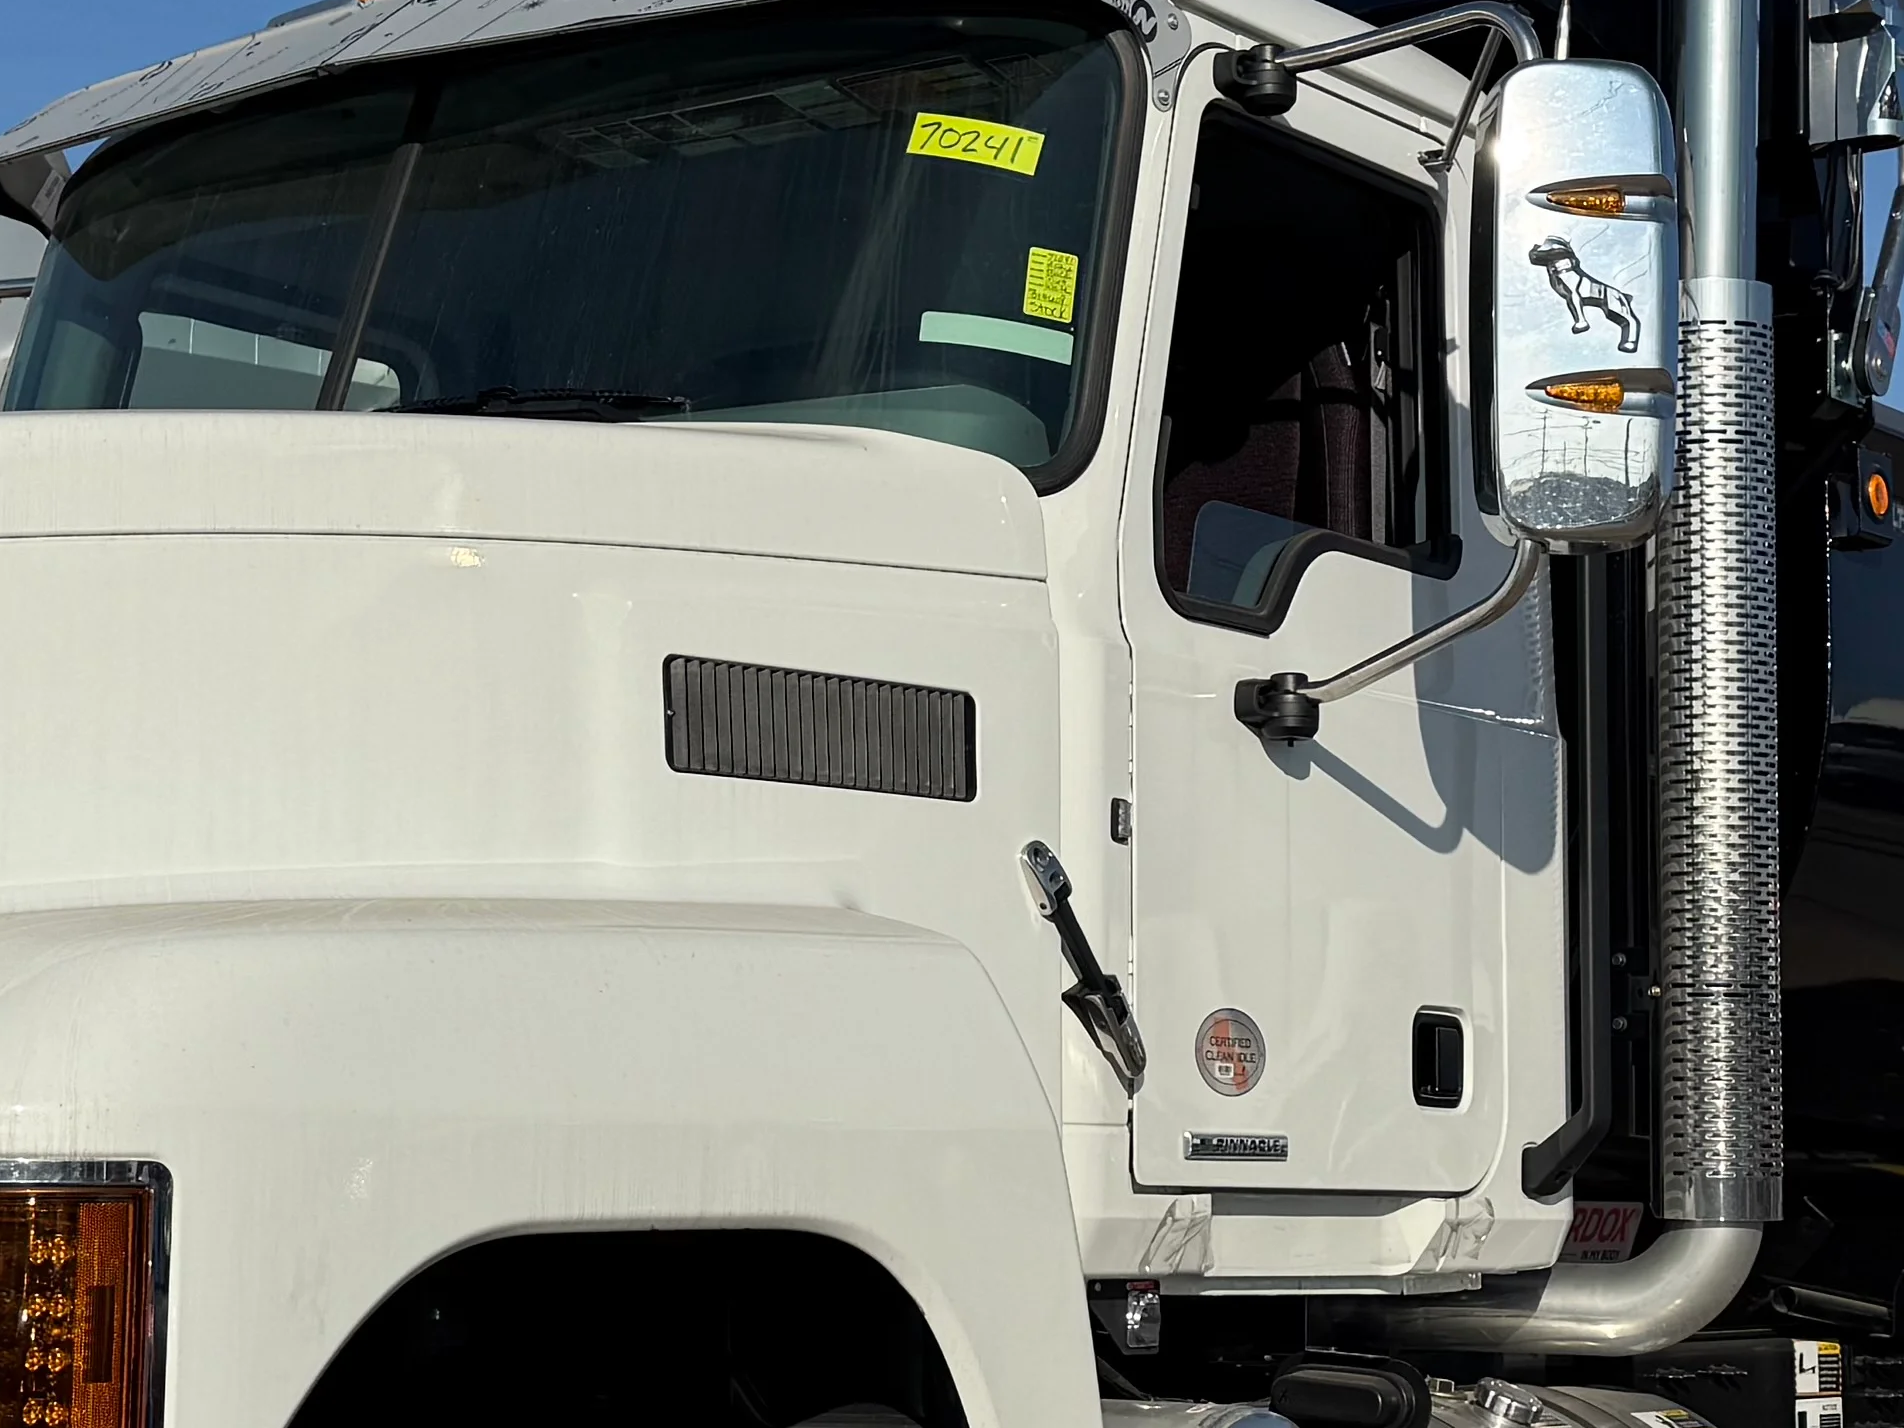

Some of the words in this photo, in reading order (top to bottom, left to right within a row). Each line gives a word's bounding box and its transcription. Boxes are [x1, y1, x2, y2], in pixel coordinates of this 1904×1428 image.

[919, 121, 1023, 164] 70241
[1209, 1036, 1252, 1049] CERTIFIED
[1205, 1050, 1235, 1062] CLEAN
[1236, 1052, 1257, 1064] IDLE
[1571, 1207, 1637, 1243] RDOX
